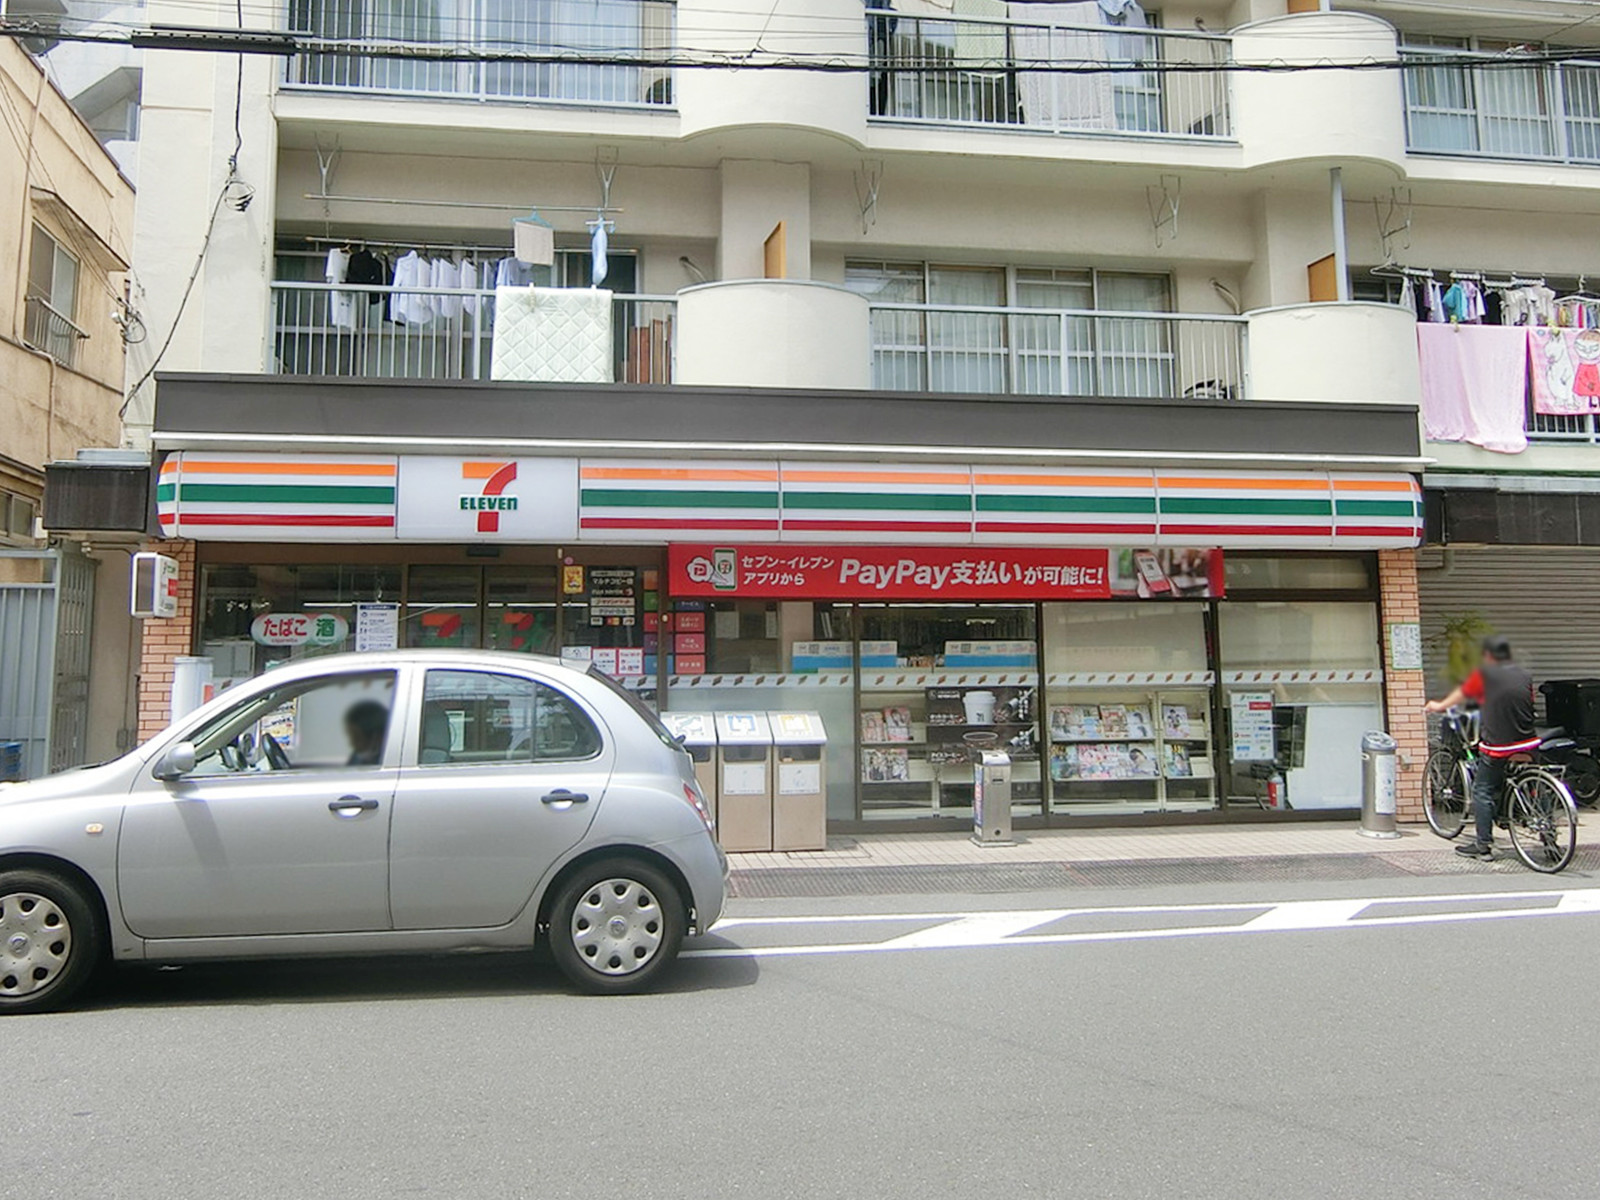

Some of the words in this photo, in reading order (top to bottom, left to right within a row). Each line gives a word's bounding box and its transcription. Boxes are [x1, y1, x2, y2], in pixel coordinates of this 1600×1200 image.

[463, 462, 517, 532] 7
[743, 572, 806, 587] アプリから
[263, 617, 308, 638] たばこ
[315, 618, 336, 638] 酒
